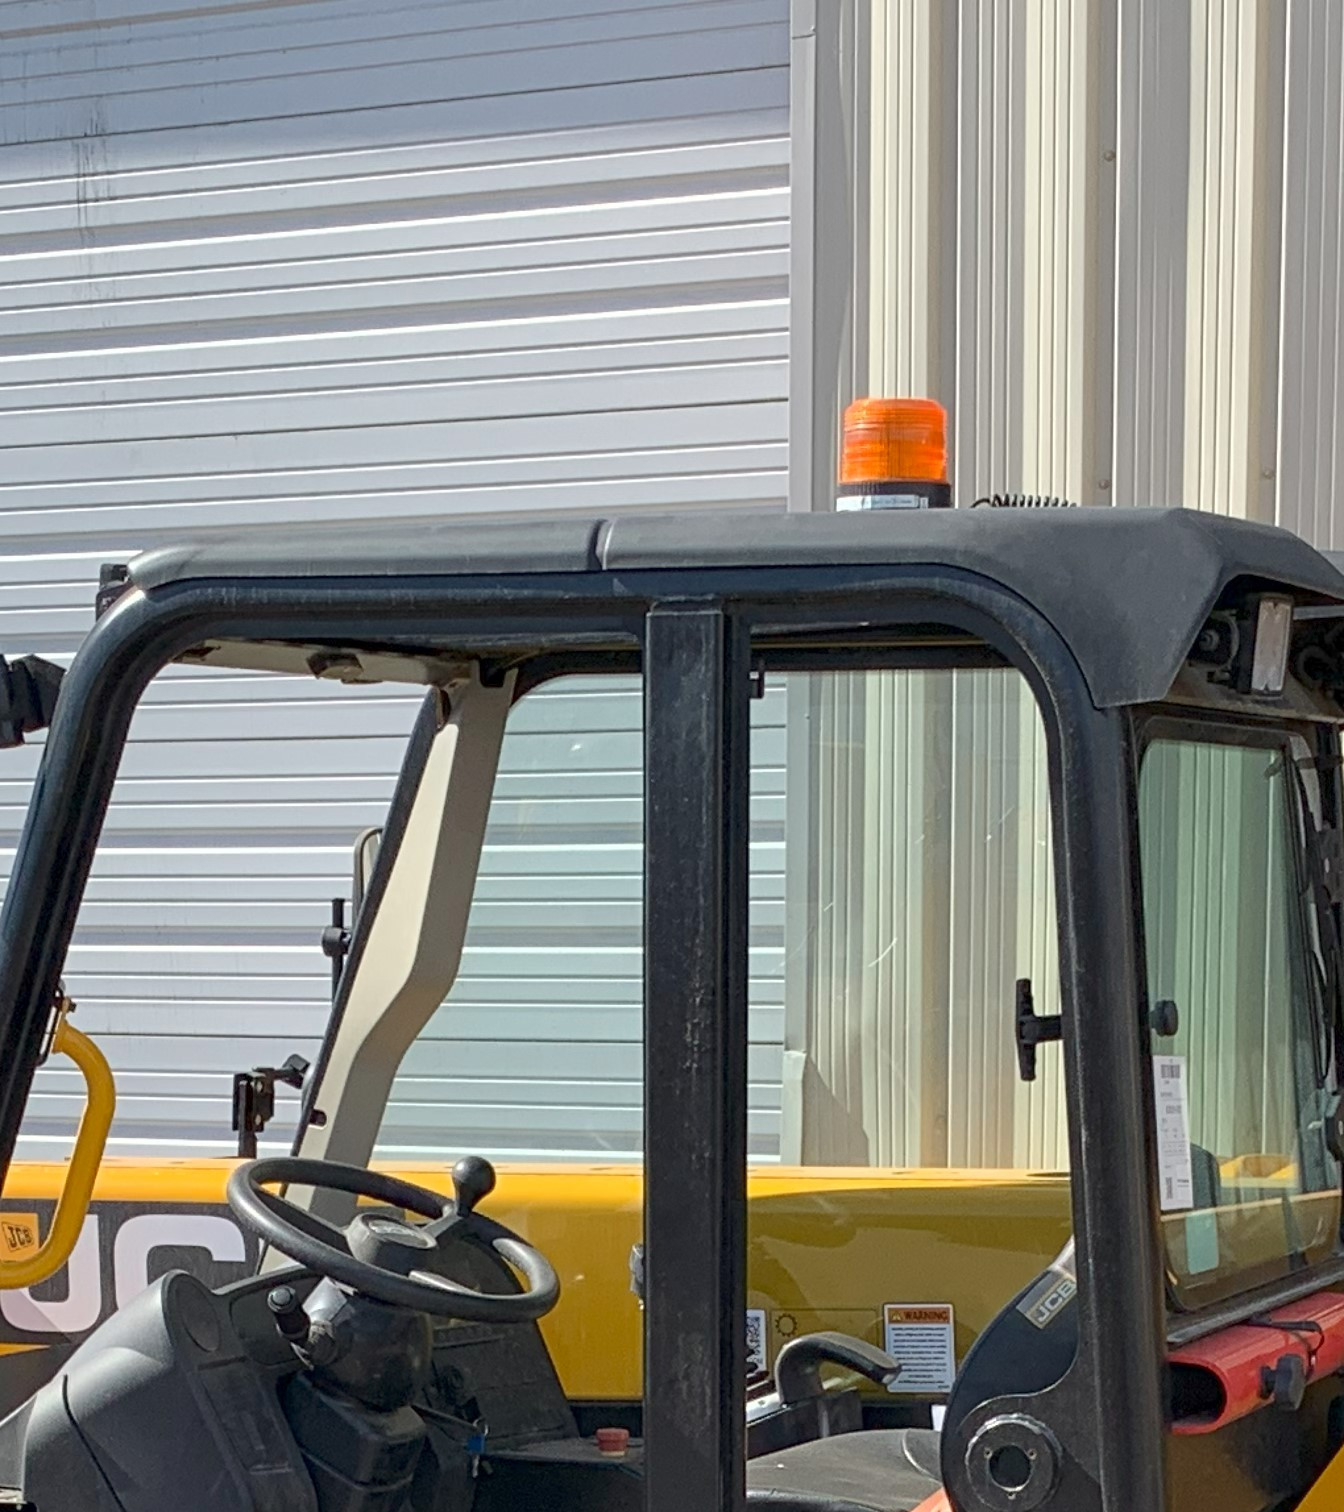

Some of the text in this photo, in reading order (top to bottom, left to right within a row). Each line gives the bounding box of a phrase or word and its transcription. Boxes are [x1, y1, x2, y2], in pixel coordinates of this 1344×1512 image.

[8, 1225, 32, 1248] JCB
[0, 1213, 268, 1333] JC
[903, 1311, 948, 1322] WARNING
[1037, 1280, 1077, 1322] JCB
